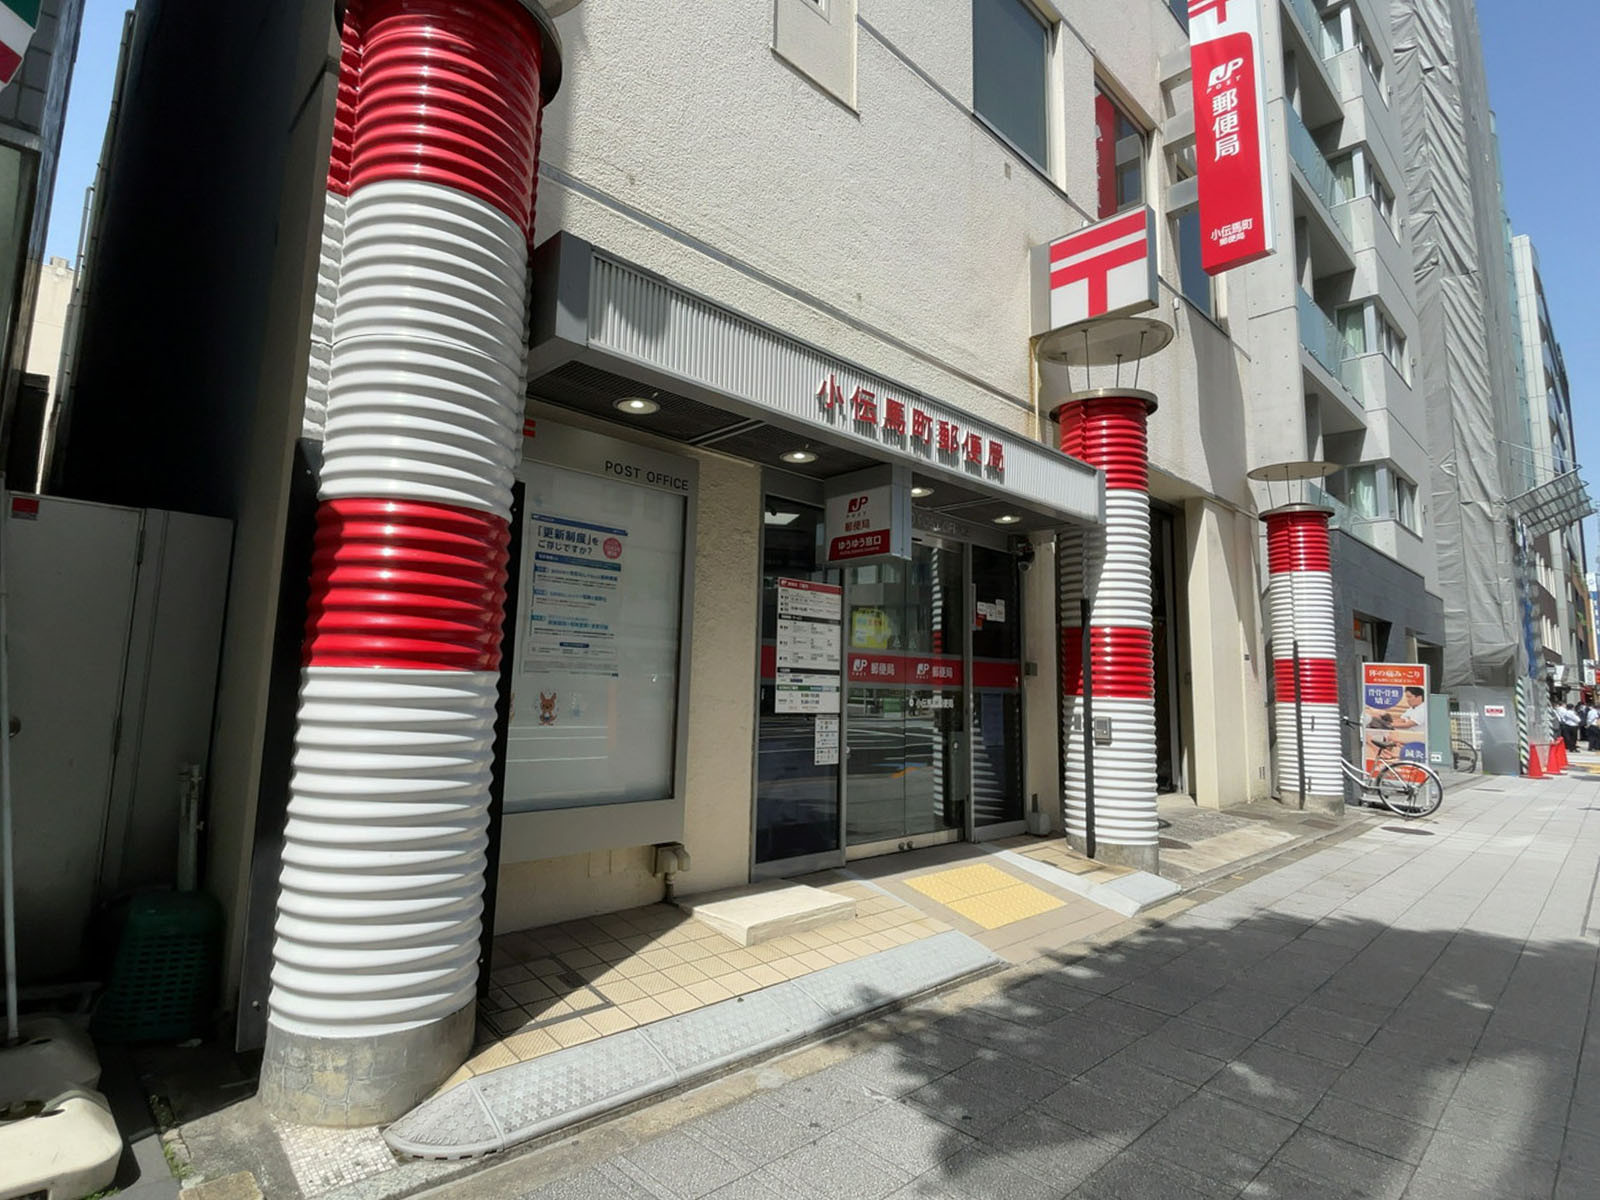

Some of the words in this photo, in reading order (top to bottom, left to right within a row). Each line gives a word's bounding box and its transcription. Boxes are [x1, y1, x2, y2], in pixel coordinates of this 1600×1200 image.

[1212, 88, 1241, 162] 郵便局
[1210, 218, 1253, 240] 小伝馬町
[816, 374, 1005, 473] 小伝馬町郵便局
[604, 460, 641, 479] POST
[646, 471, 689, 491] OFFICE
[838, 535, 881, 550] ゆうゆう窓口
[870, 662, 895, 676] 郵便局
